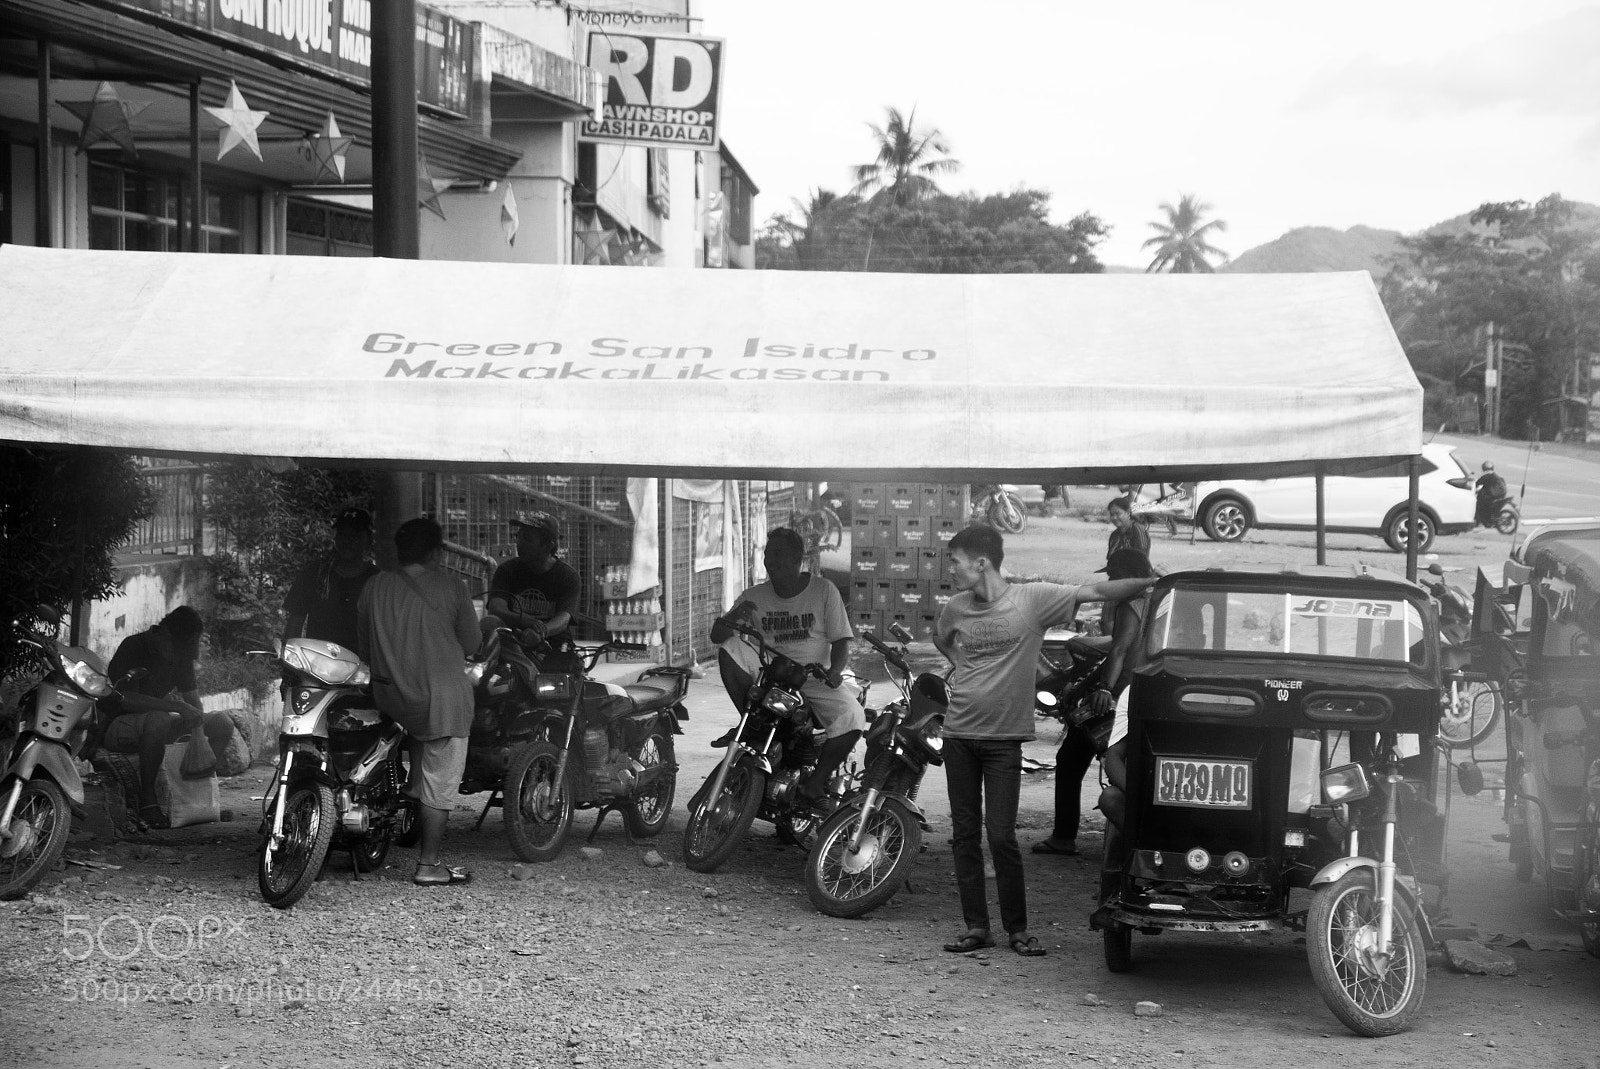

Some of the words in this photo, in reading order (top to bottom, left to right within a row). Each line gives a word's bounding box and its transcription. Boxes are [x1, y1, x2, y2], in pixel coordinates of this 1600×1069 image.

[577, 10, 680, 28] MoneyGram
[589, 33, 713, 109] RD
[592, 104, 714, 126] AWNSHOP
[586, 121, 636, 137] CASH
[638, 124, 711, 142] PADALA
[362, 332, 562, 356] Green
[588, 337, 713, 359] San
[743, 337, 936, 361] Isidro
[801, 613, 815, 629] UP
[1264, 679, 1303, 690] PIONEER
